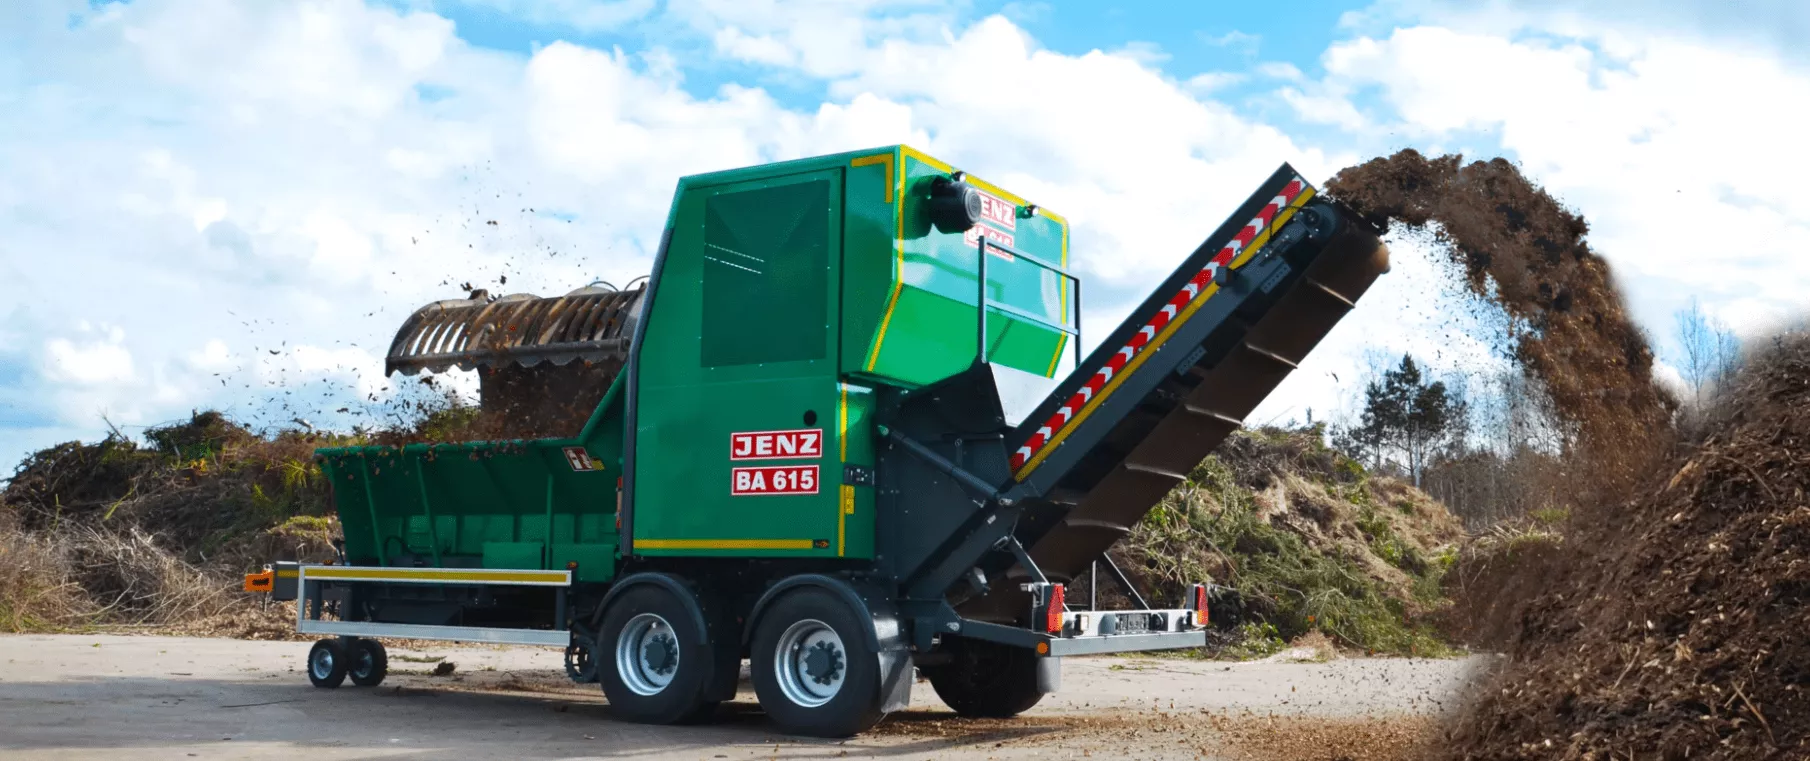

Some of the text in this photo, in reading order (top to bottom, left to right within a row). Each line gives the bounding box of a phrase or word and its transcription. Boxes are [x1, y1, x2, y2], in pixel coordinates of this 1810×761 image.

[980, 196, 1013, 225] ENZ
[735, 434, 818, 456] JENZ
[737, 470, 814, 491] BA 615
